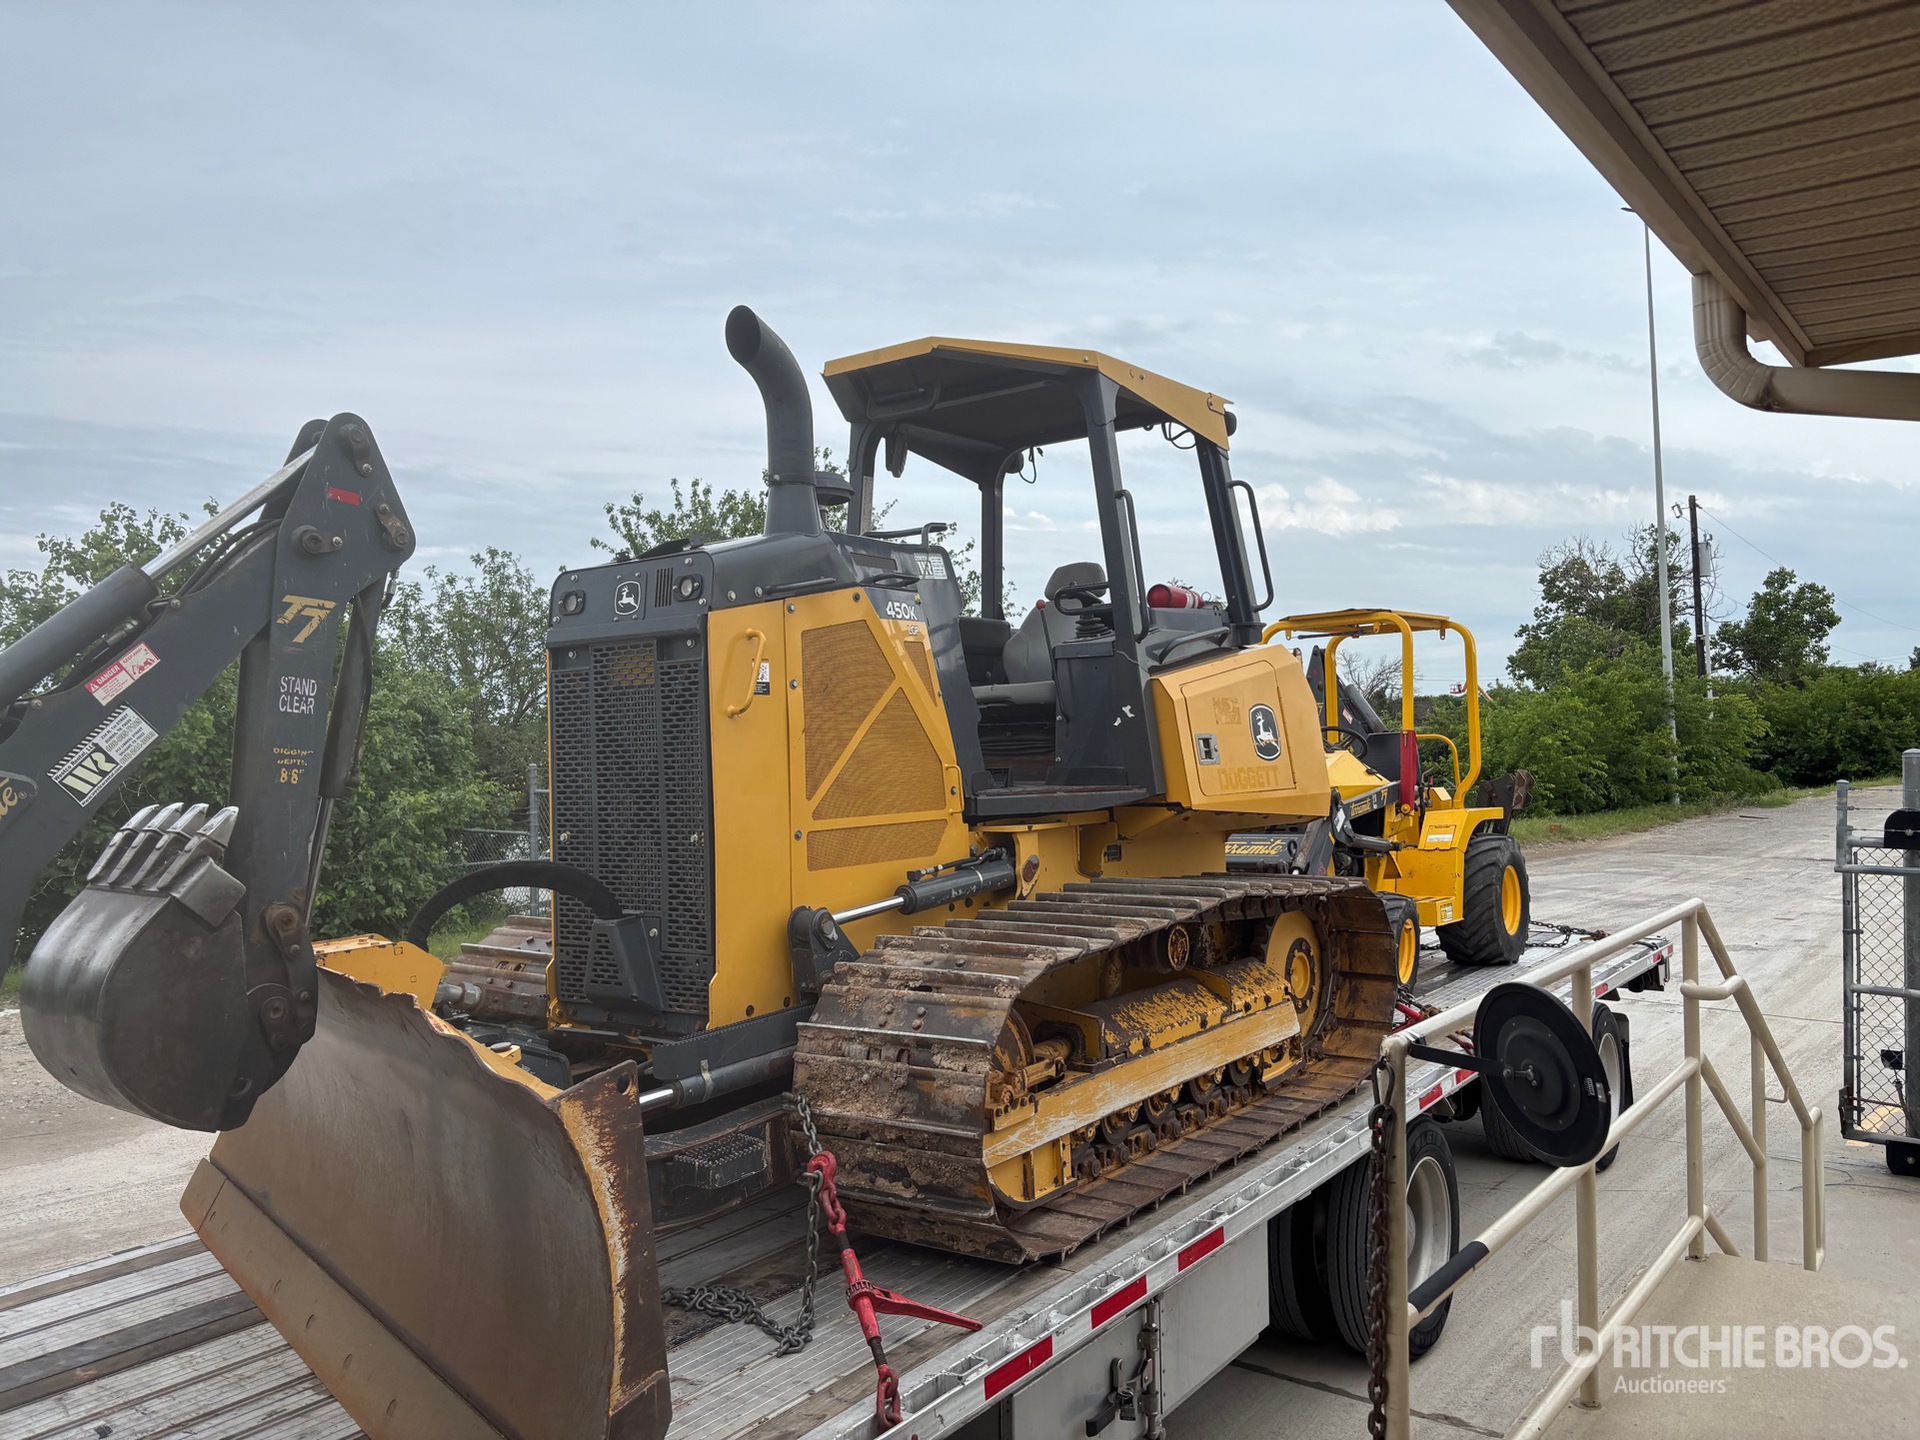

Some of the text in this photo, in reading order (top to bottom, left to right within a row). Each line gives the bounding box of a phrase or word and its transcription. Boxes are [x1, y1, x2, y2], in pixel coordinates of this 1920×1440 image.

[886, 601, 917, 620] 450K
[96, 664, 120, 685] DANGER
[280, 675, 317, 696] STAND
[279, 694, 315, 714] CLEAR
